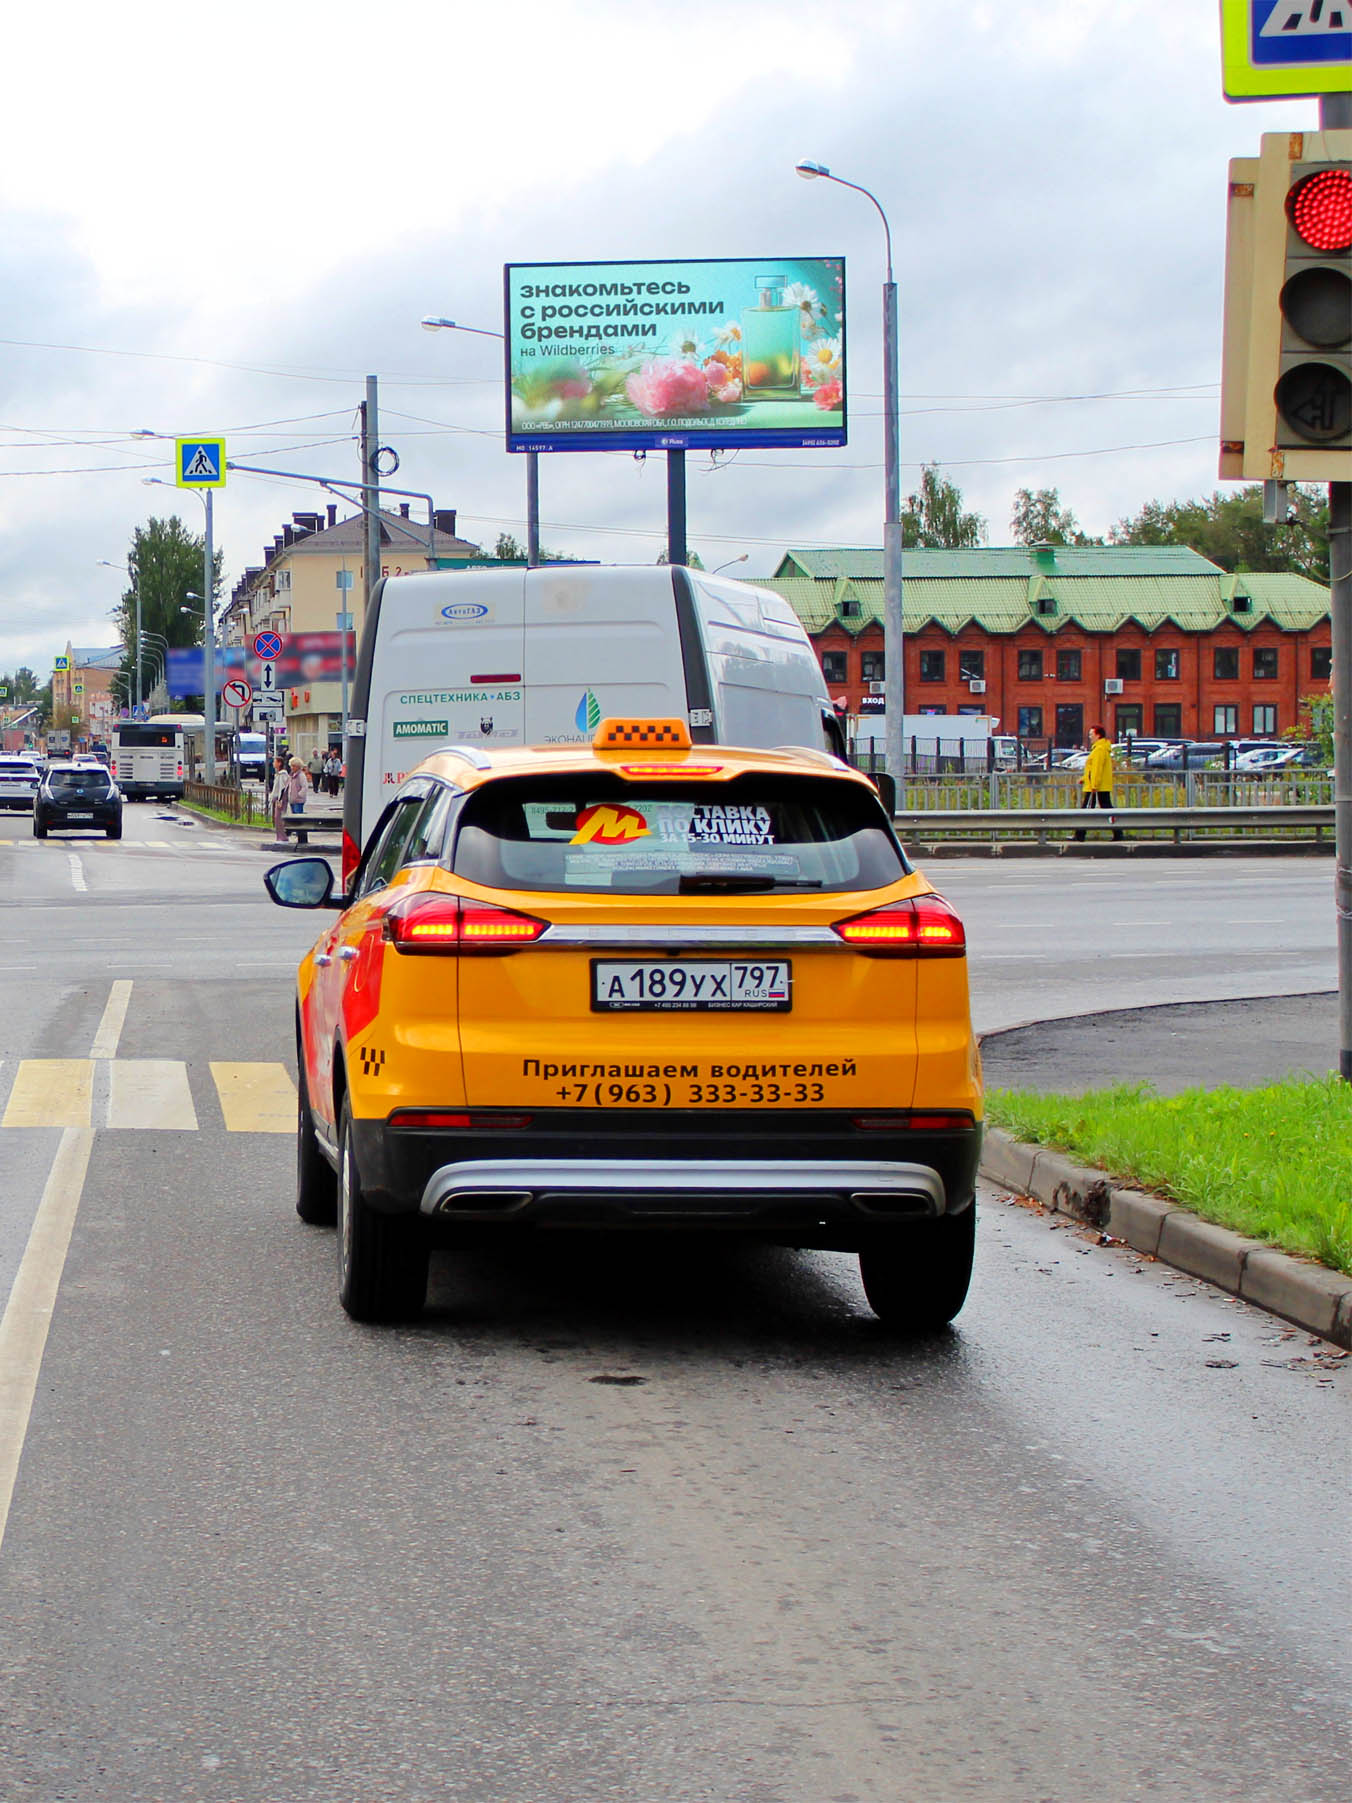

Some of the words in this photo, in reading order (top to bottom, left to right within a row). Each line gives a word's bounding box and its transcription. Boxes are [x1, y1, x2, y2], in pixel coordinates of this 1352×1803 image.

[520, 281, 691, 298] знакомьтесь
[520, 305, 536, 319] с
[541, 298, 725, 321] российскими
[520, 322, 657, 342] брендами
[520, 346, 536, 357] на
[540, 344, 616, 356] Wildberries
[400, 692, 488, 705] СПЕЦТЕХНИКА
[496, 691, 521, 701] АБЗ
[862, 697, 885, 705] ВХОД
[395, 723, 446, 735] AMOMATIC
[658, 819, 691, 833] ПО
[694, 818, 771, 835] КЛИКУ
[660, 833, 680, 843] ЗА
[683, 832, 721, 844] 15-30
[722, 833, 775, 845] МИНУТ
[608, 968, 728, 998] А189УХ
[734, 966, 780, 989] 797
[744, 989, 767, 998] RUS
[522, 1059, 699, 1080] Приглашаем
[710, 1058, 857, 1081] водителей
[688, 1083, 825, 1103] 333-33-33
